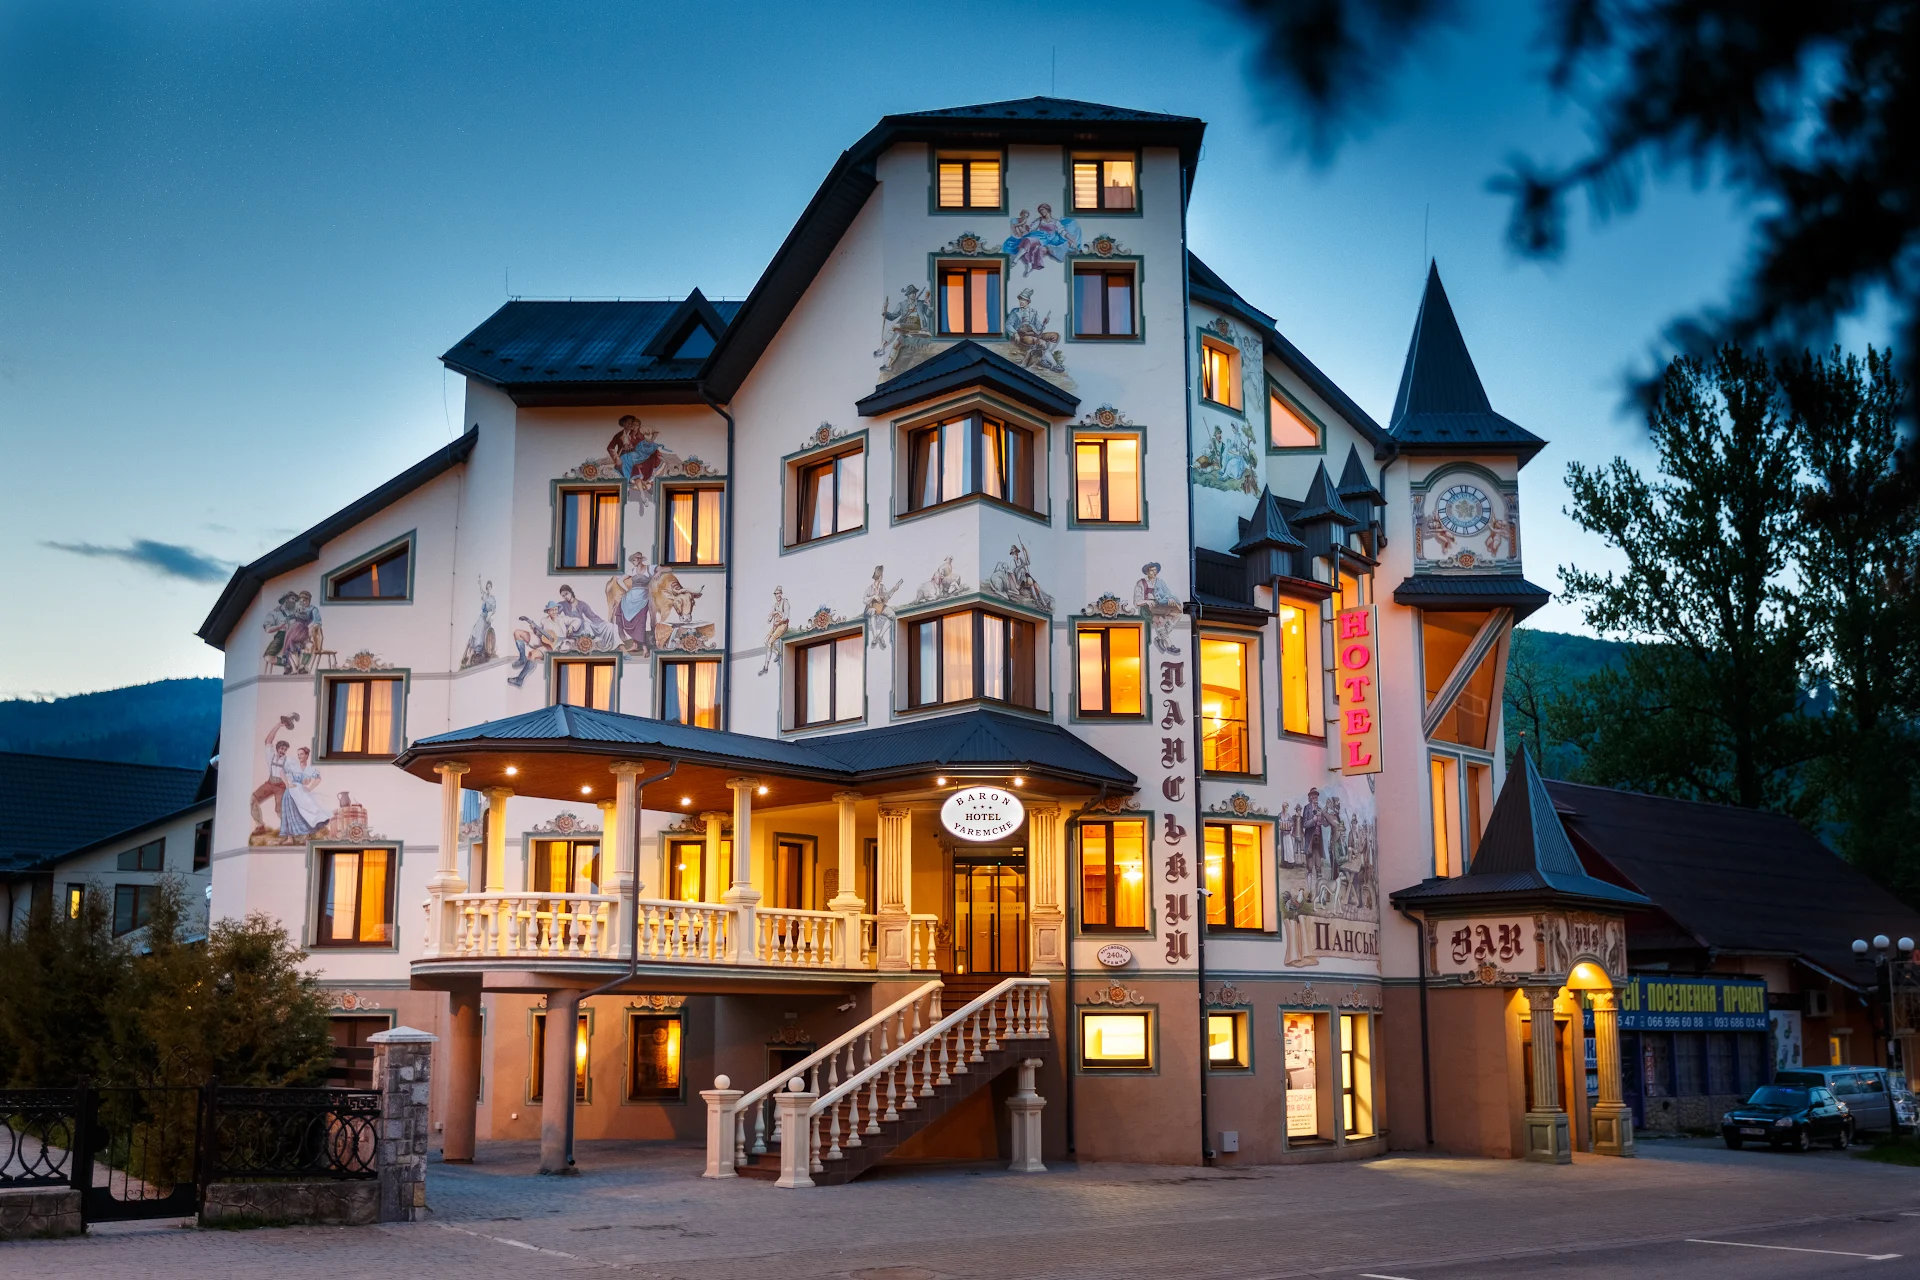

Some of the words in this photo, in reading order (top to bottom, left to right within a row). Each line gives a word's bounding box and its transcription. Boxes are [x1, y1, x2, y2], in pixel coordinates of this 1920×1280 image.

[1340, 610, 1372, 767] HOTEL
[956, 793, 1011, 806] BARON
[965, 813, 1002, 821] HOTEL
[1160, 661, 1192, 965] ПАНСЬКИЙ
[954, 821, 1014, 837] YAREMCHE
[1451, 924, 1524, 965] BAR
[1647, 983, 1717, 1013] ПОСЕЛЕННЯ
[1723, 985, 1765, 1013] ПРОКАТ
[1624, 1015, 1635, 1027] 47
[1647, 1016, 1663, 1027] 066
[1664, 1016, 1680, 1027] 996
[1681, 1017, 1692, 1027] 60
[1714, 1017, 1729, 1027] 093
[1745, 1017, 1755, 1028] 03
[1286, 1094, 1312, 1103] СТОРАН
